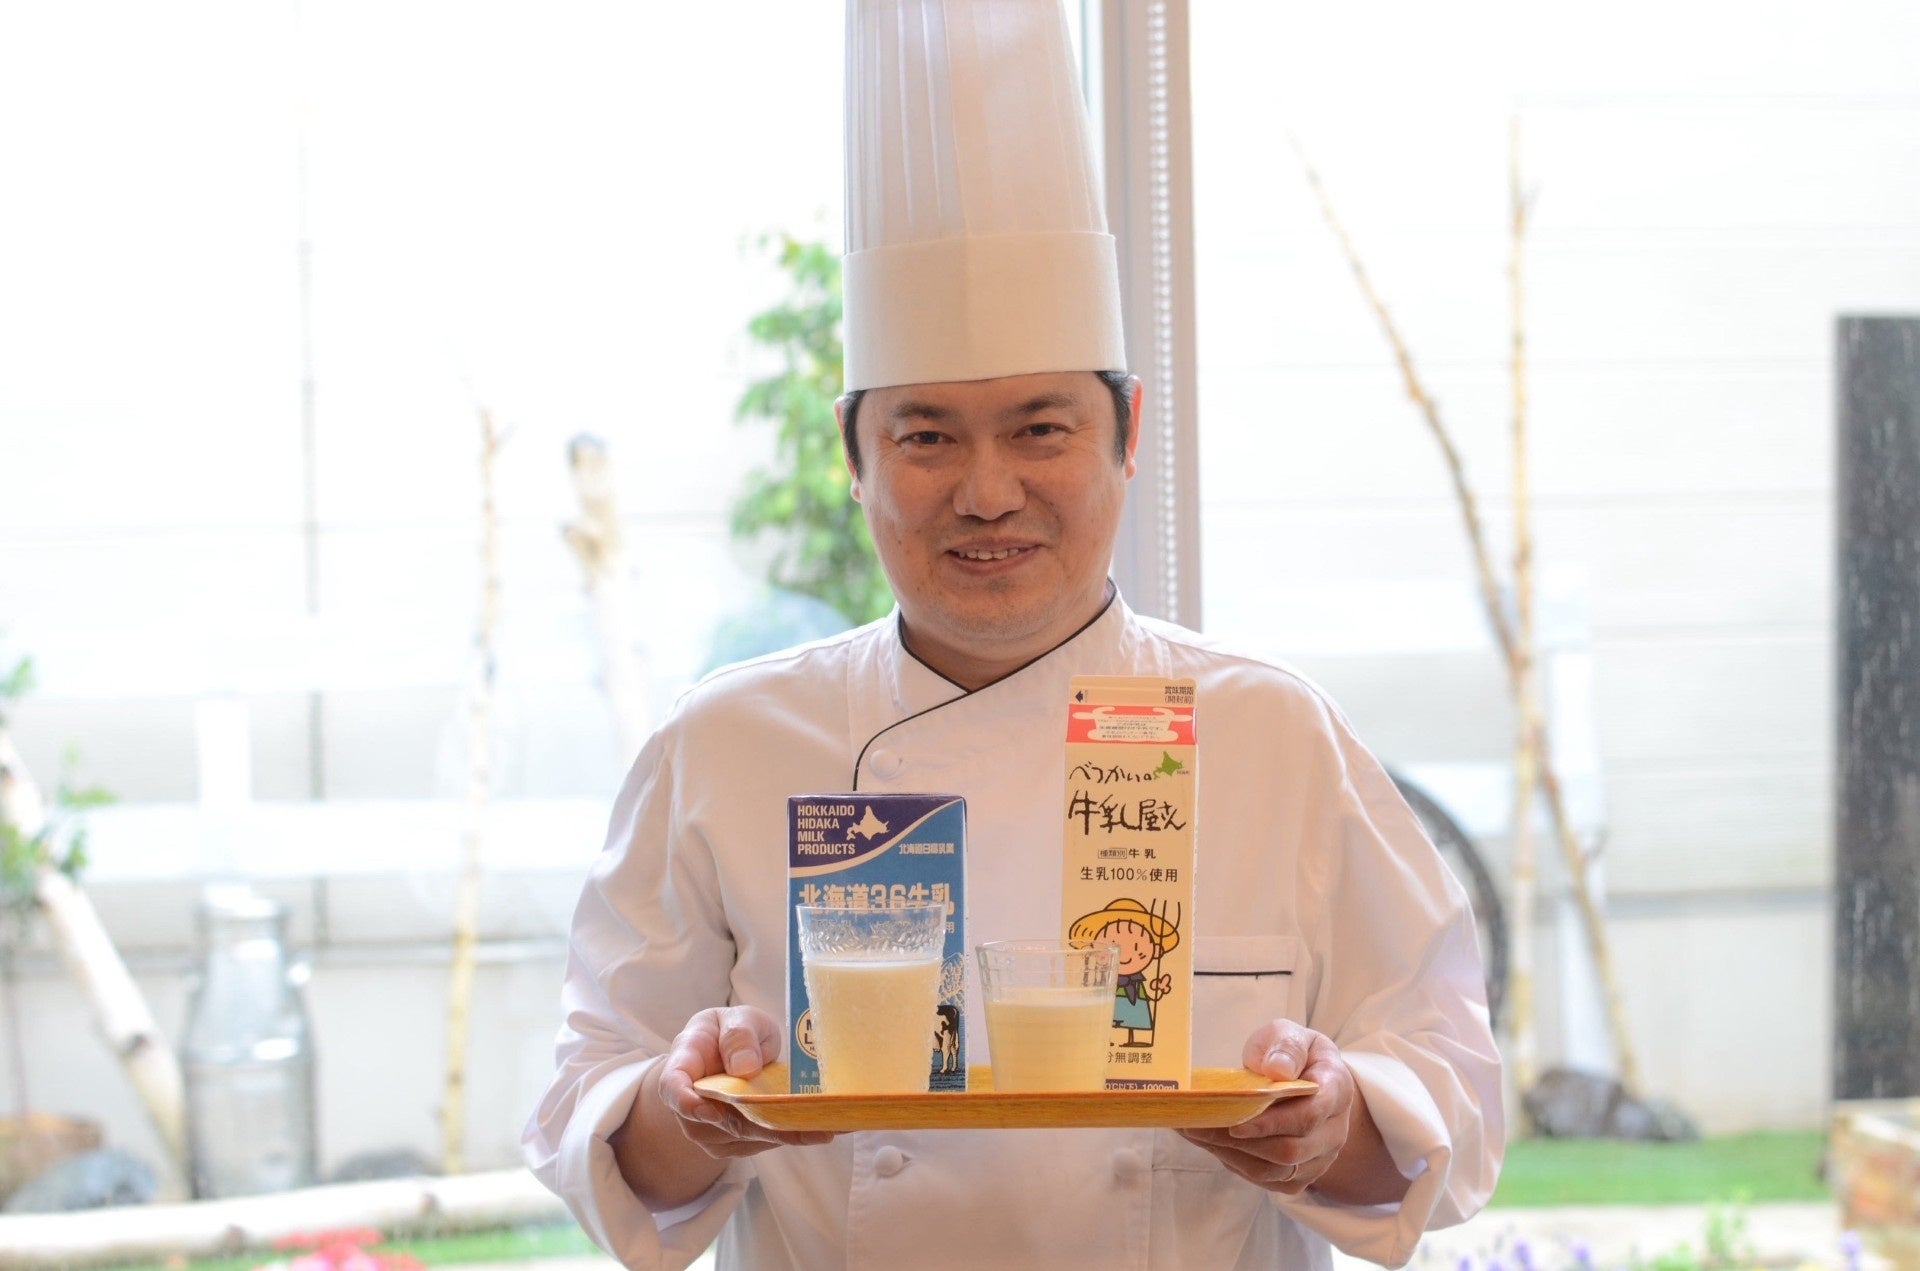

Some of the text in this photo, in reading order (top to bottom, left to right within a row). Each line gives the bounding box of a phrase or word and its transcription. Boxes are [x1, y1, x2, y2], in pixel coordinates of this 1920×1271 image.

[1069, 761, 1153, 784] べつかいの
[797, 805, 855, 816] HOKKAIDO
[1068, 790, 1187, 835] 牛乳屋さん
[797, 818, 840, 829] HIDAKA
[797, 831, 825, 842] MILK
[797, 844, 856, 855] PRODUCTS
[1081, 867, 1178, 883] 生乳100%使用
